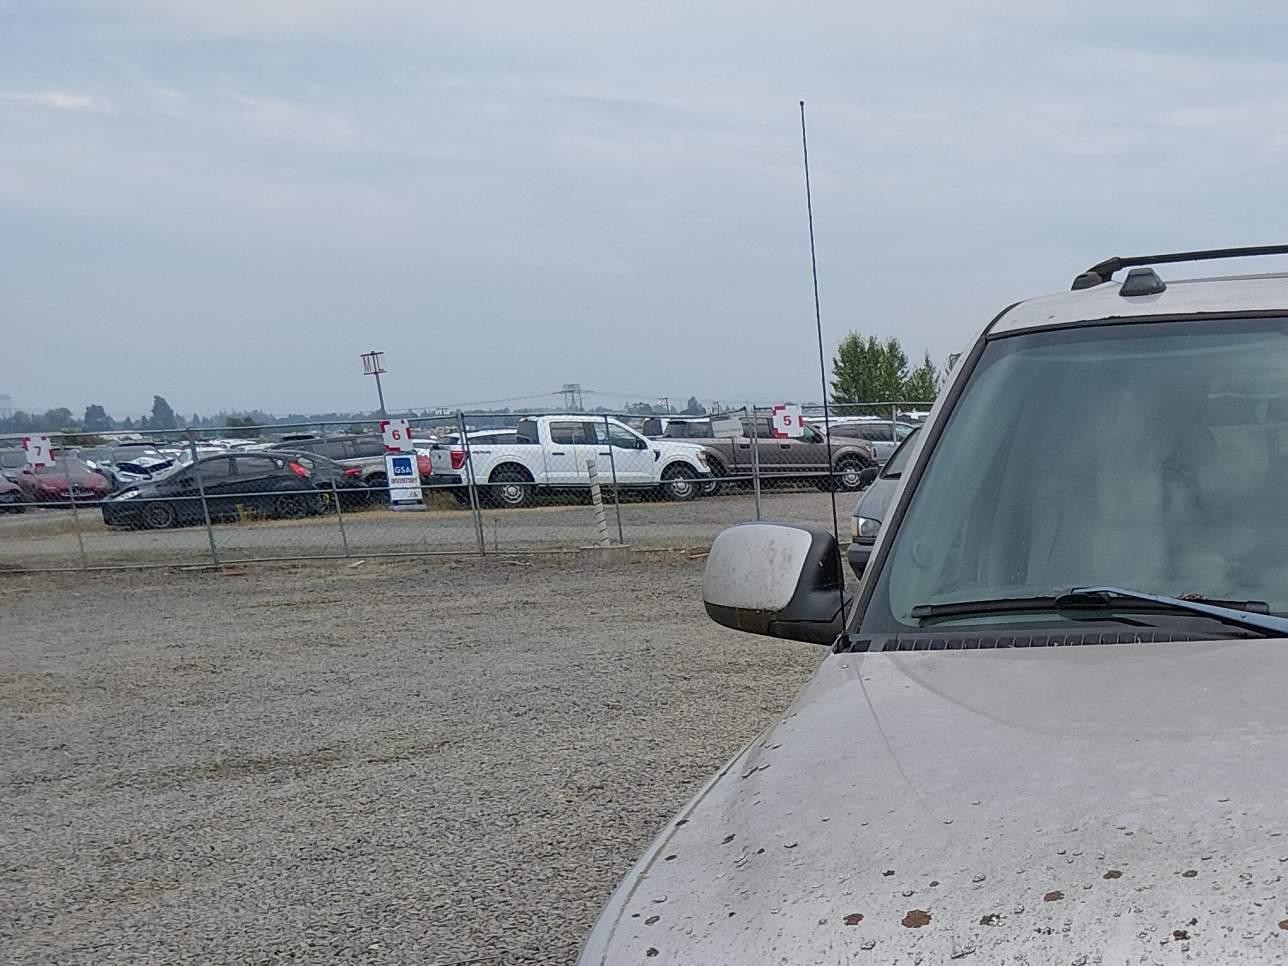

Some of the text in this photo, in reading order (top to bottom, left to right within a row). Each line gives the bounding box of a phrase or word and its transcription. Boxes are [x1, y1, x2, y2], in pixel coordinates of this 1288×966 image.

[783, 415, 792, 426] 5
[392, 430, 401, 440] 6
[33, 446, 41, 456] 7
[394, 466, 412, 474] GSA
